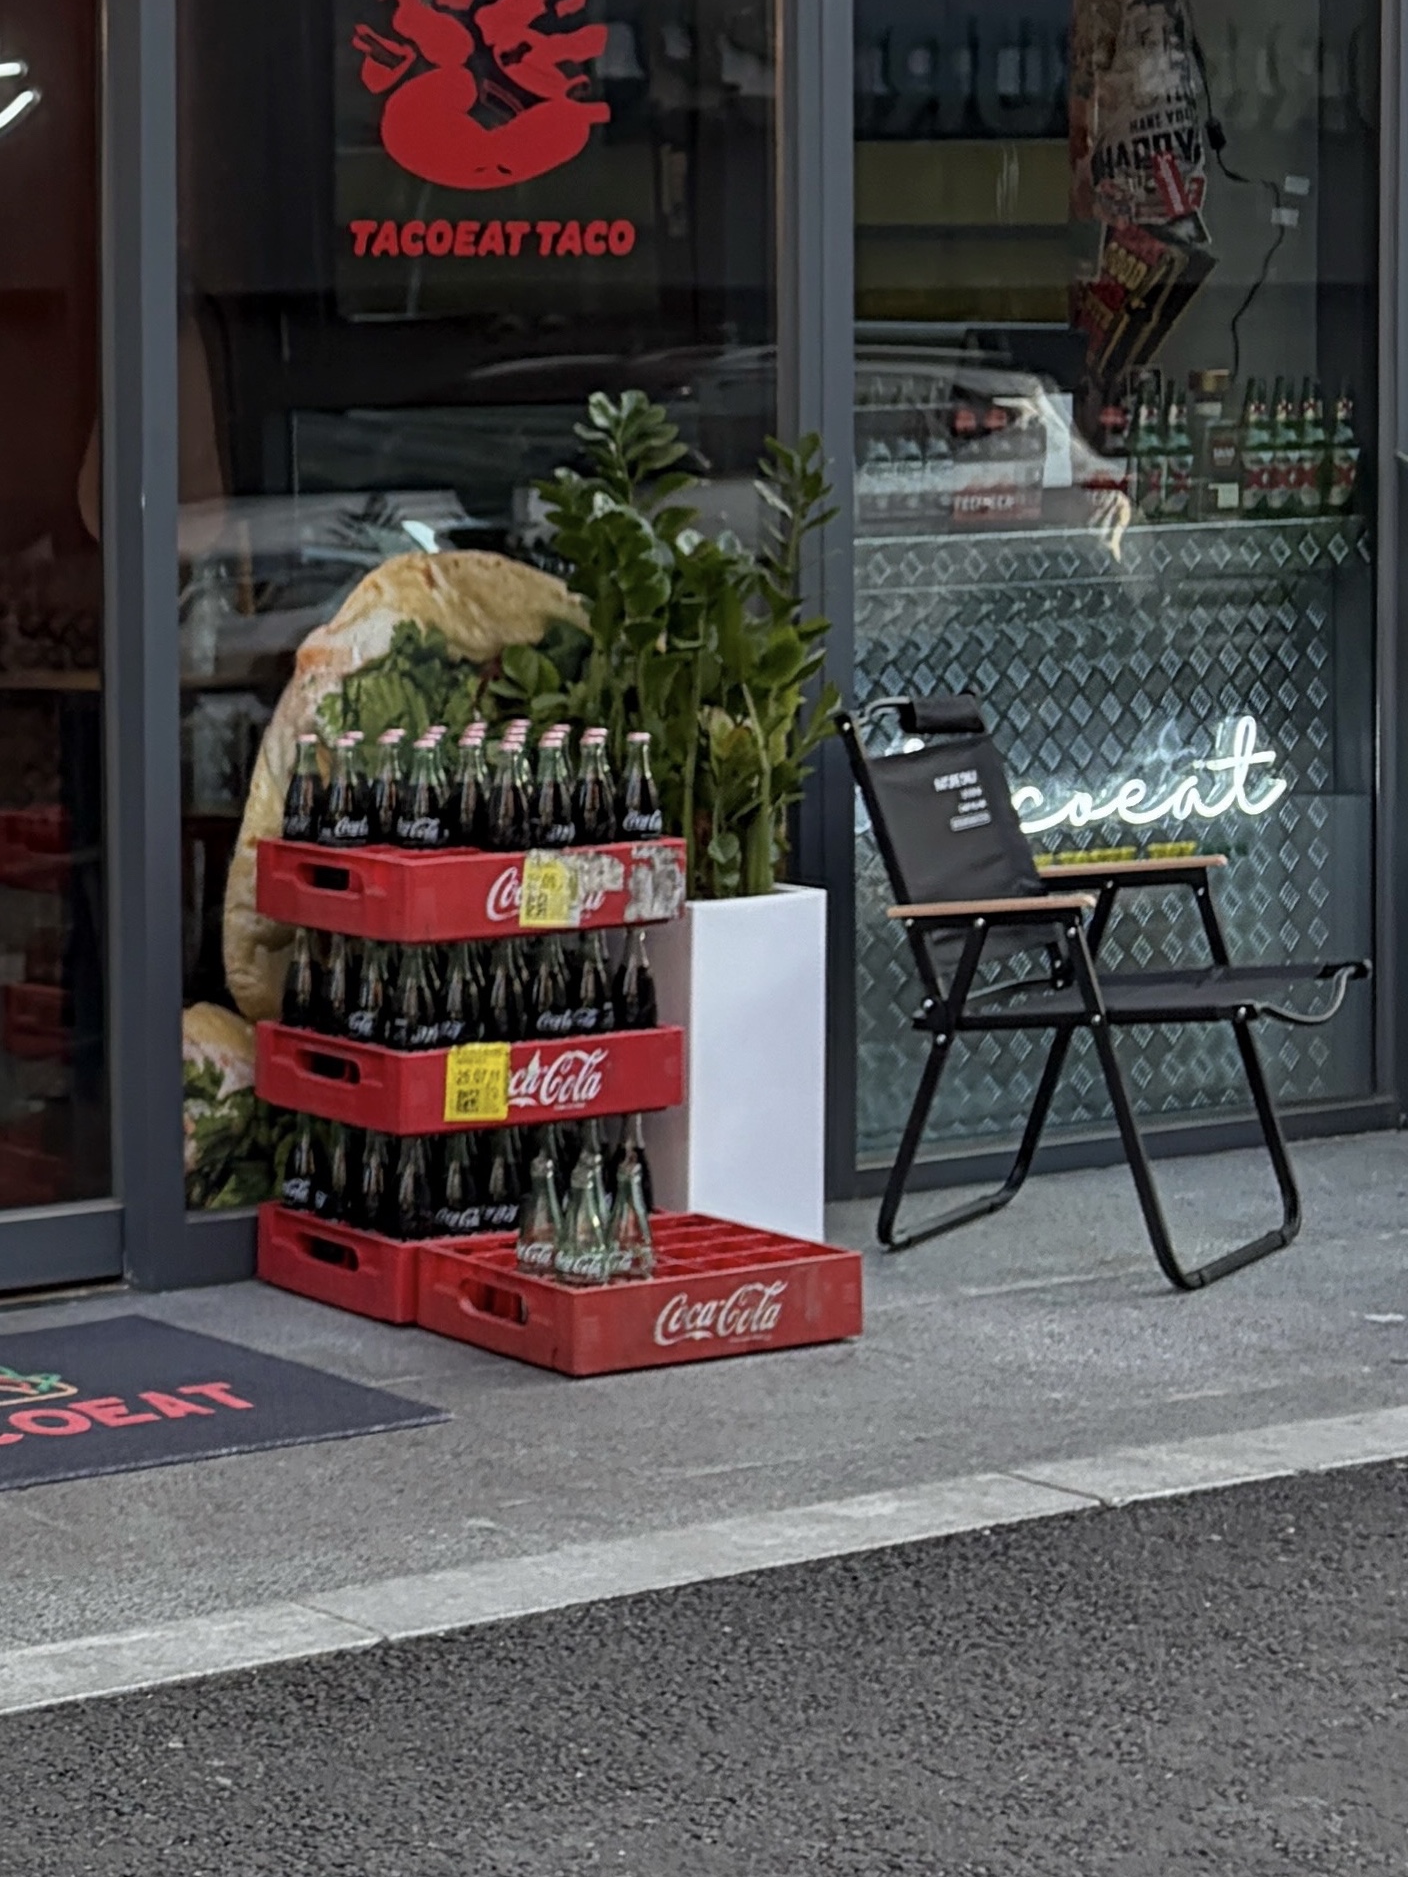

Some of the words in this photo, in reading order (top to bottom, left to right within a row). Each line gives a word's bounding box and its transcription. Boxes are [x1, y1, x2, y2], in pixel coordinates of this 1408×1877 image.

[349, 220, 535, 258] TACOEAT
[536, 220, 636, 258] TACO
[1012, 714, 1288, 836] coeat
[507, 1046, 609, 1108] ca-Cola
[653, 1279, 789, 1347] Coca-Cola
